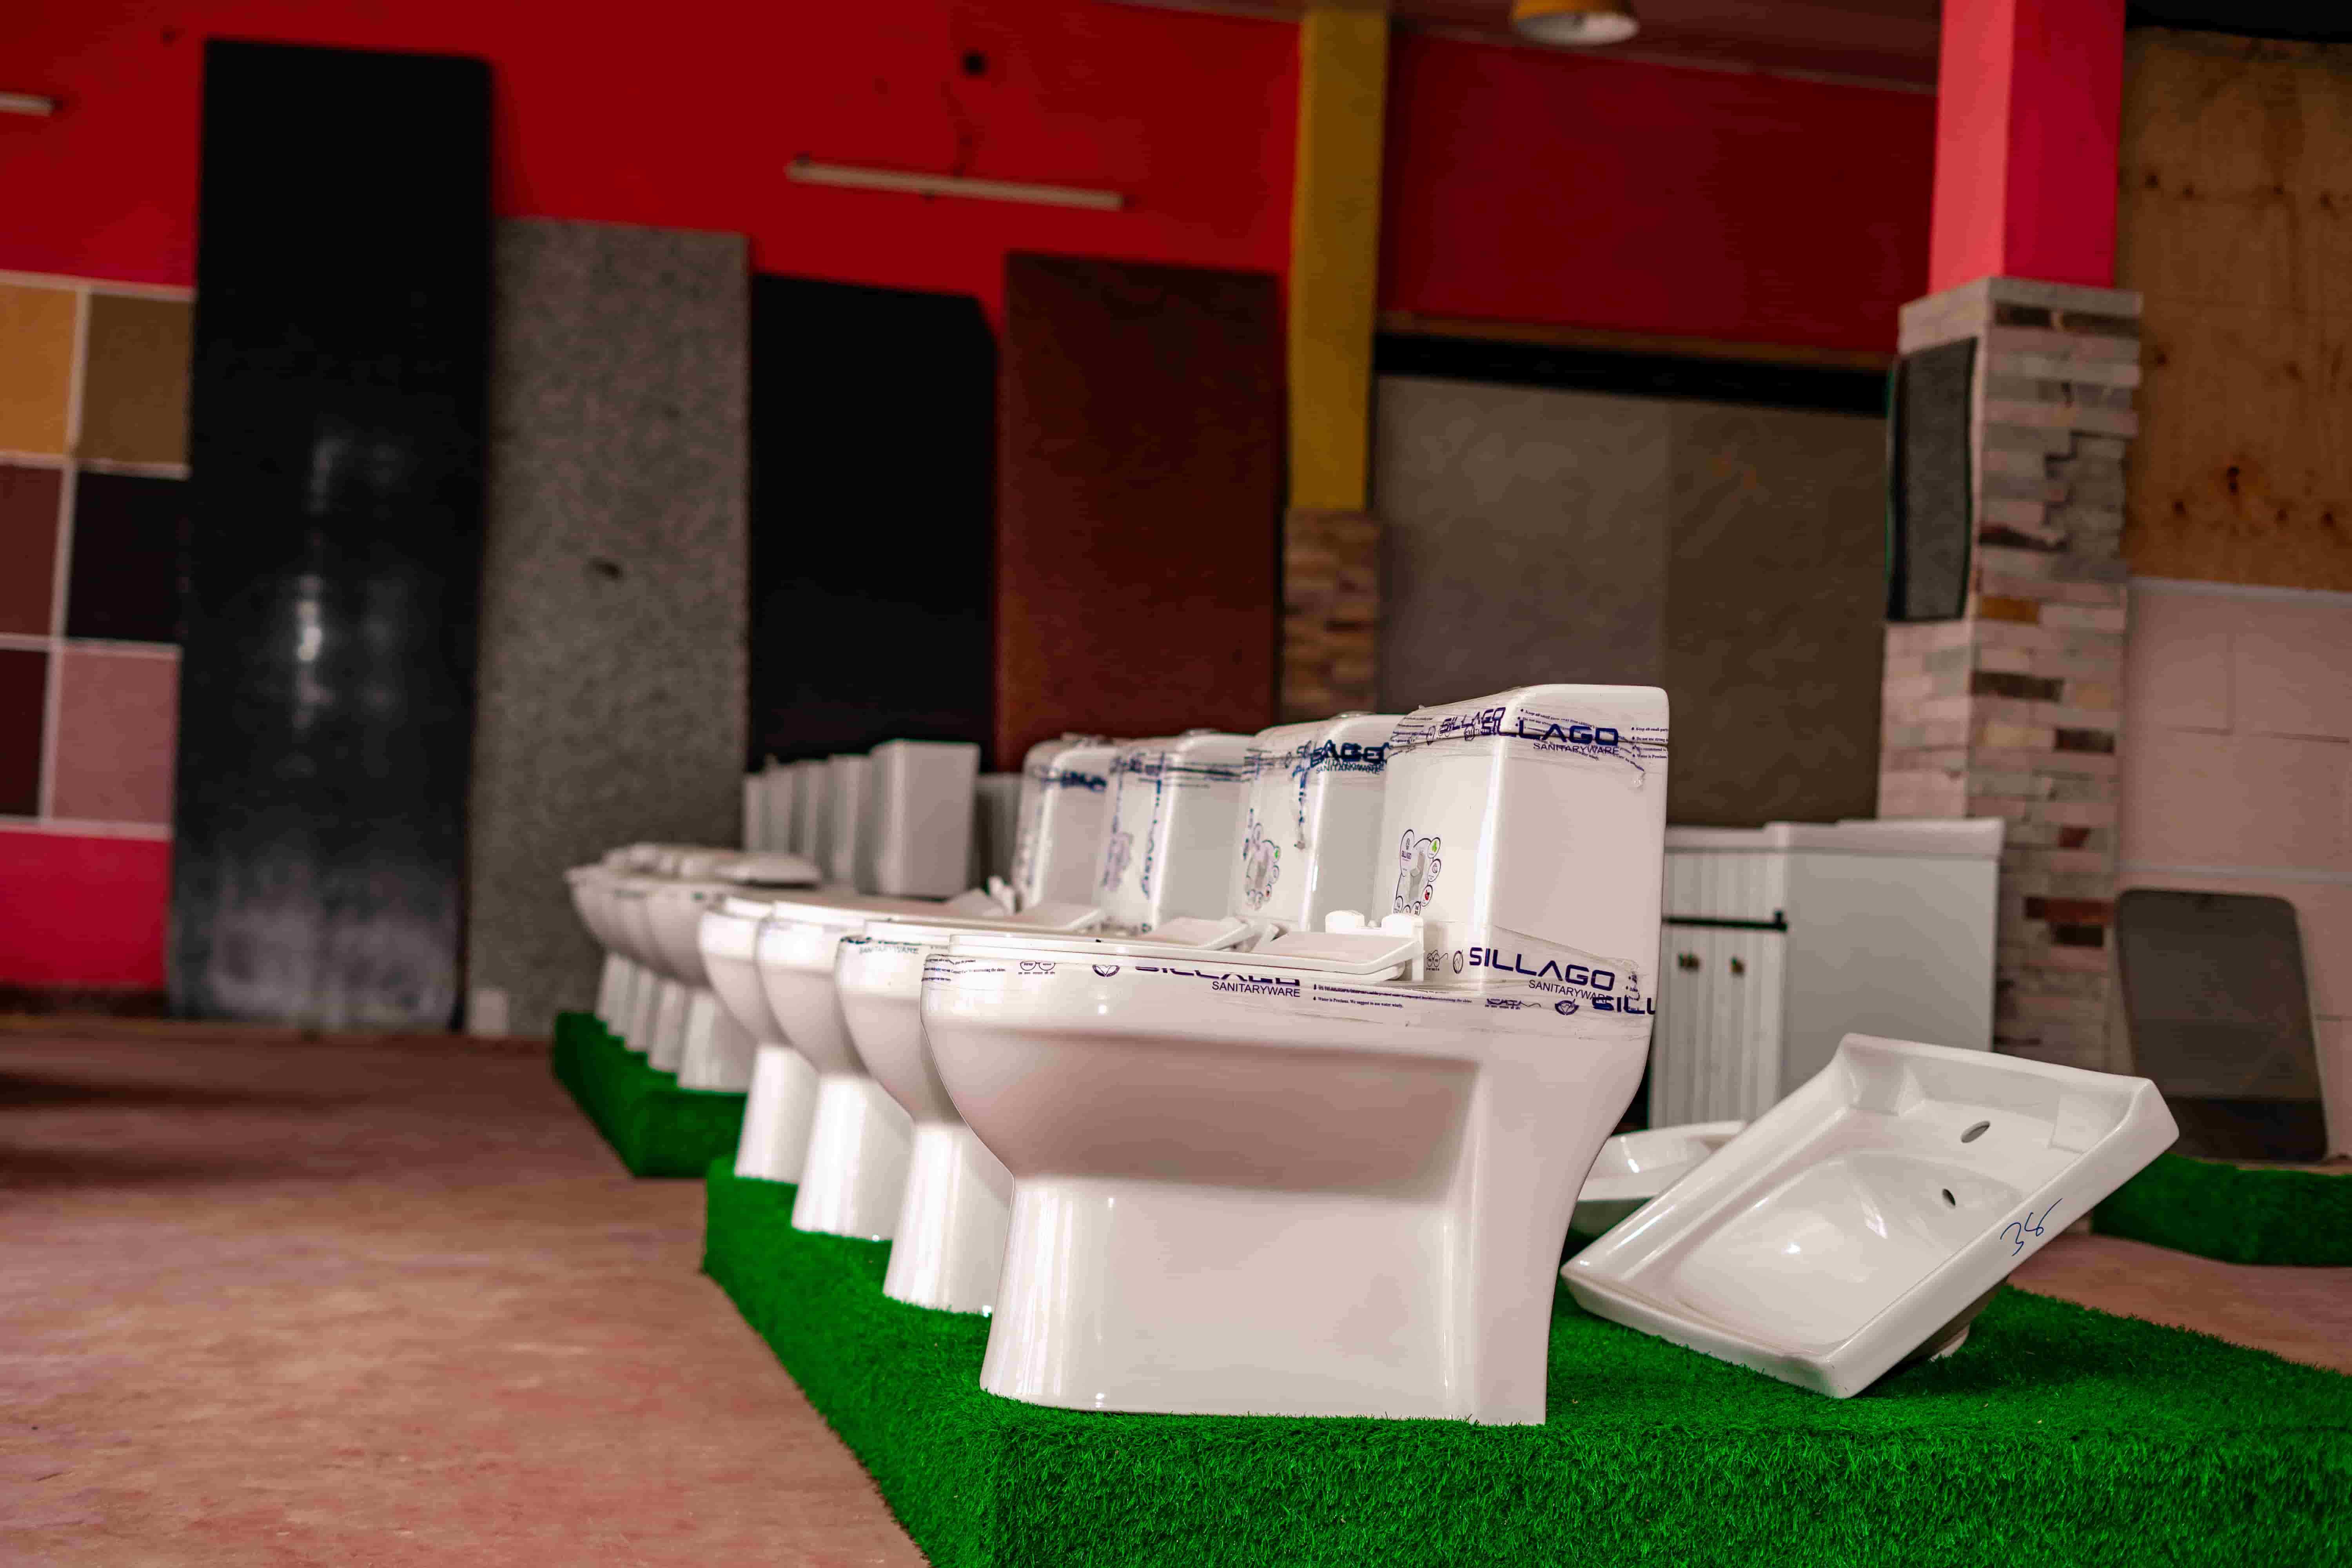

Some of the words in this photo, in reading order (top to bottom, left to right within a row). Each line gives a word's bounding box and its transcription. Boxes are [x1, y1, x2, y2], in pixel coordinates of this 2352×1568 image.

[1533, 743, 1620, 755] SANITARYWARE
[1401, 850, 1412, 860] SILLAGO
[1469, 947, 1615, 991] SILLAGO
[1212, 981, 1301, 997] SANITARYWARE
[1528, 980, 1613, 1002] SANITARYWAR
